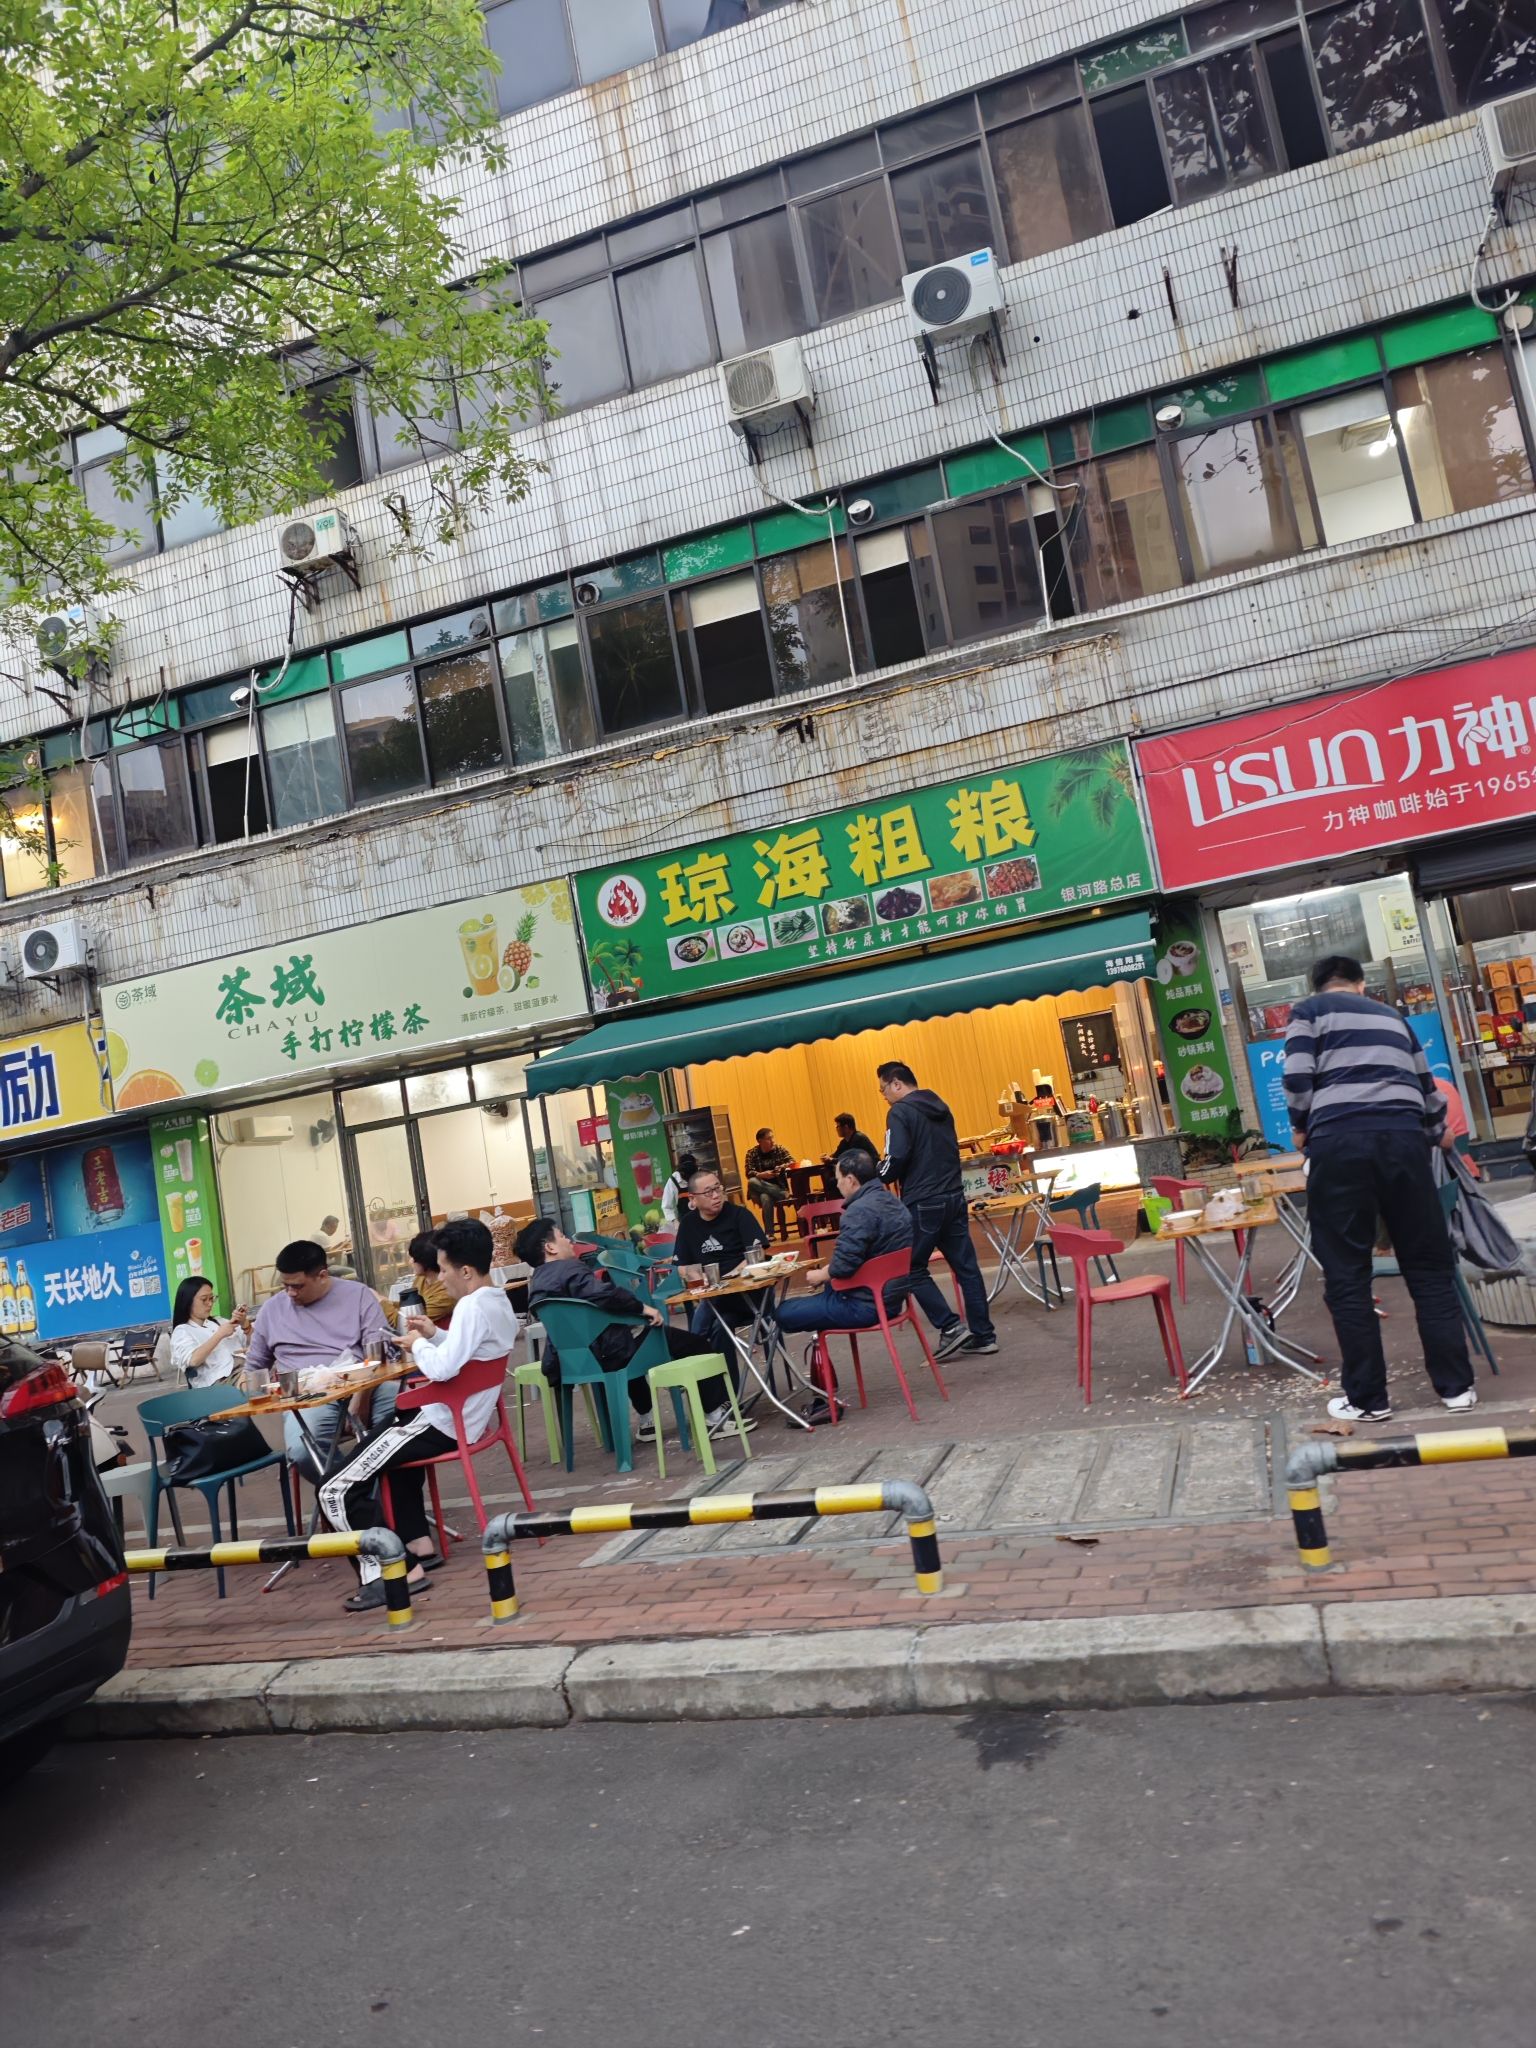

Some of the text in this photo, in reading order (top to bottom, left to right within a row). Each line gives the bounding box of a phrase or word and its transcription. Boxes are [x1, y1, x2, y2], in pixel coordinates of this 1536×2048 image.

[1388, 695, 1536, 783] 力神
[656, 779, 1037, 926] 琼海粗粮
[1060, 873, 1142, 902] 银河路总店
[808, 897, 1028, 959] 坚持好原料才能呵护你的胃
[131, 984, 157, 1002] 茶域
[215, 954, 325, 1025] 茶域
[227, 1010, 319, 1040] CHAYU
[280, 1003, 430, 1061] 手打柠檬茶
[1177, 1040, 1215, 1058] 砂锅系列
[1190, 1105, 1229, 1122] 甜品系列
[93, 1155, 109, 1203] 王老吉
[43, 1261, 123, 1308] 天长地久
